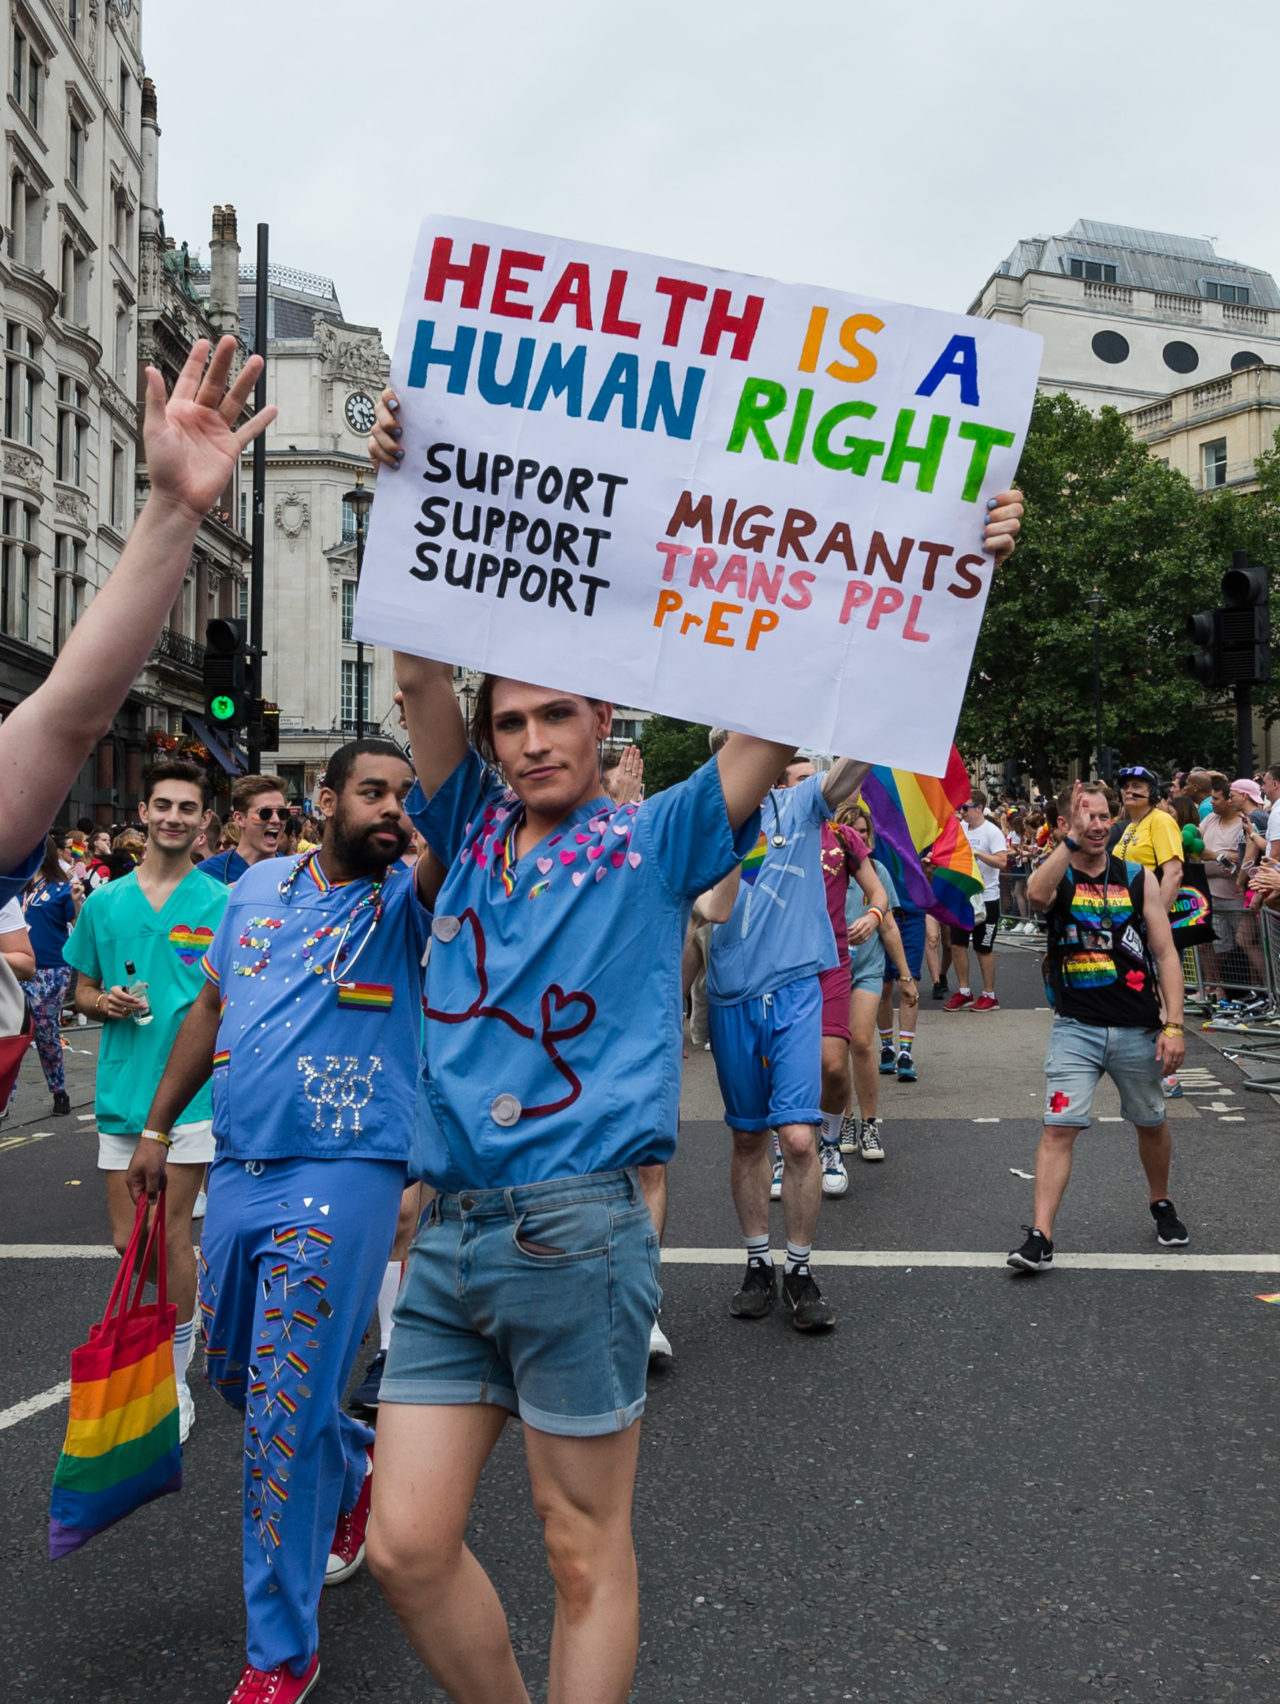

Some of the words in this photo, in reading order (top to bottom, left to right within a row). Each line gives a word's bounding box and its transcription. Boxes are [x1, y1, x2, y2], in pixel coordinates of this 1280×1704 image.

[424, 236, 764, 361] HEALTH
[798, 306, 885, 383] IS
[915, 334, 980, 406] A
[407, 319, 706, 440] HUMAN
[726, 378, 1015, 503] RIGHT
[409, 542, 610, 617] SUPPORT
[652, 590, 779, 651] PrEP
[415, 496, 611, 567] SUPPORT
[656, 542, 816, 611] TRANS
[838, 579, 931, 642] PPL
[423, 442, 628, 517] SUPPORT
[665, 490, 984, 600] MIGRANTS
[1169, 897, 1205, 913] ONDON
